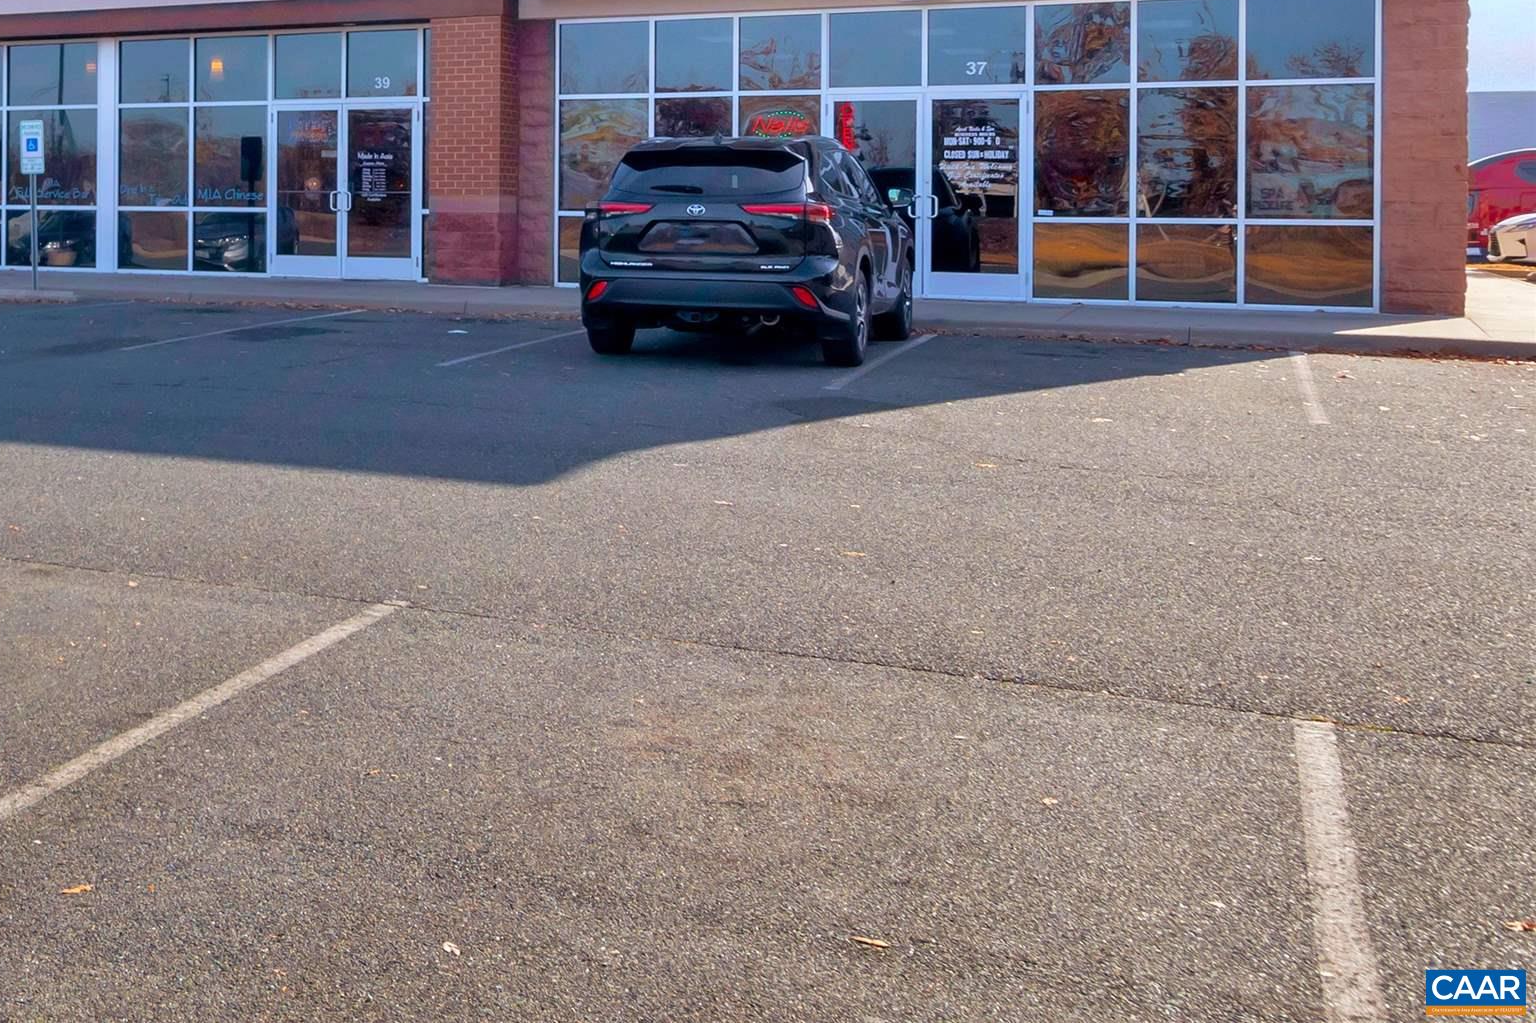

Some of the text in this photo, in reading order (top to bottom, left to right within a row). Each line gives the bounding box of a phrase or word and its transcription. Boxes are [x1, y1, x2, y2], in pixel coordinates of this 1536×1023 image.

[965, 61, 987, 76] 37
[374, 76, 391, 89] 39
[752, 114, 810, 134] Nails
[944, 150, 966, 159] CLOSED
[224, 187, 264, 201] Chinese
